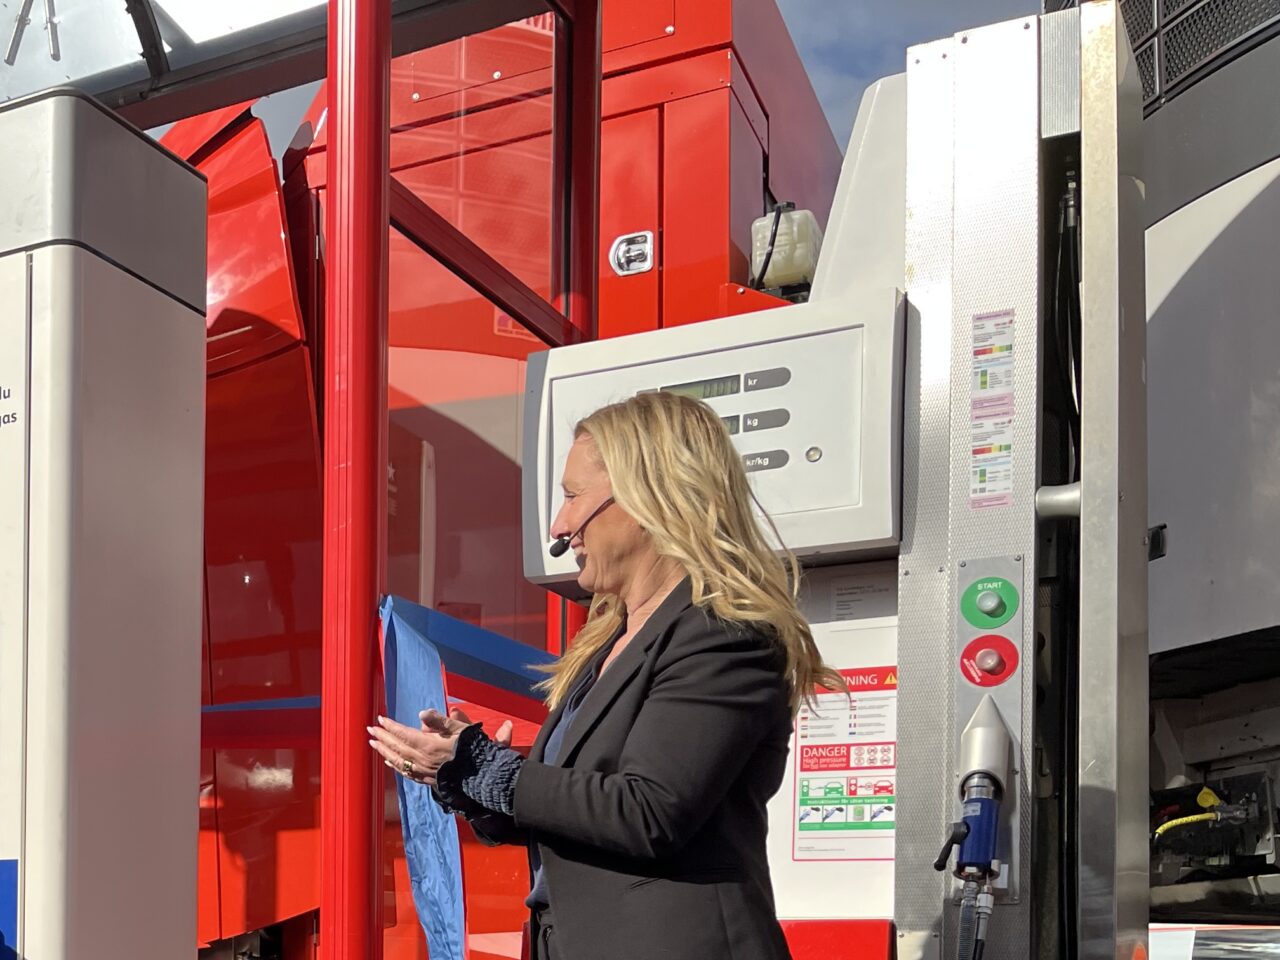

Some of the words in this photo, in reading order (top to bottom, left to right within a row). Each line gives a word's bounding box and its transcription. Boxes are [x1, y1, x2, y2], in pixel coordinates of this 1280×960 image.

[748, 378, 758, 386] kr
[747, 418, 759, 427] kg
[746, 456, 770, 467] kr/kg
[977, 582, 1002, 590] START
[803, 746, 847, 757] DANGER
